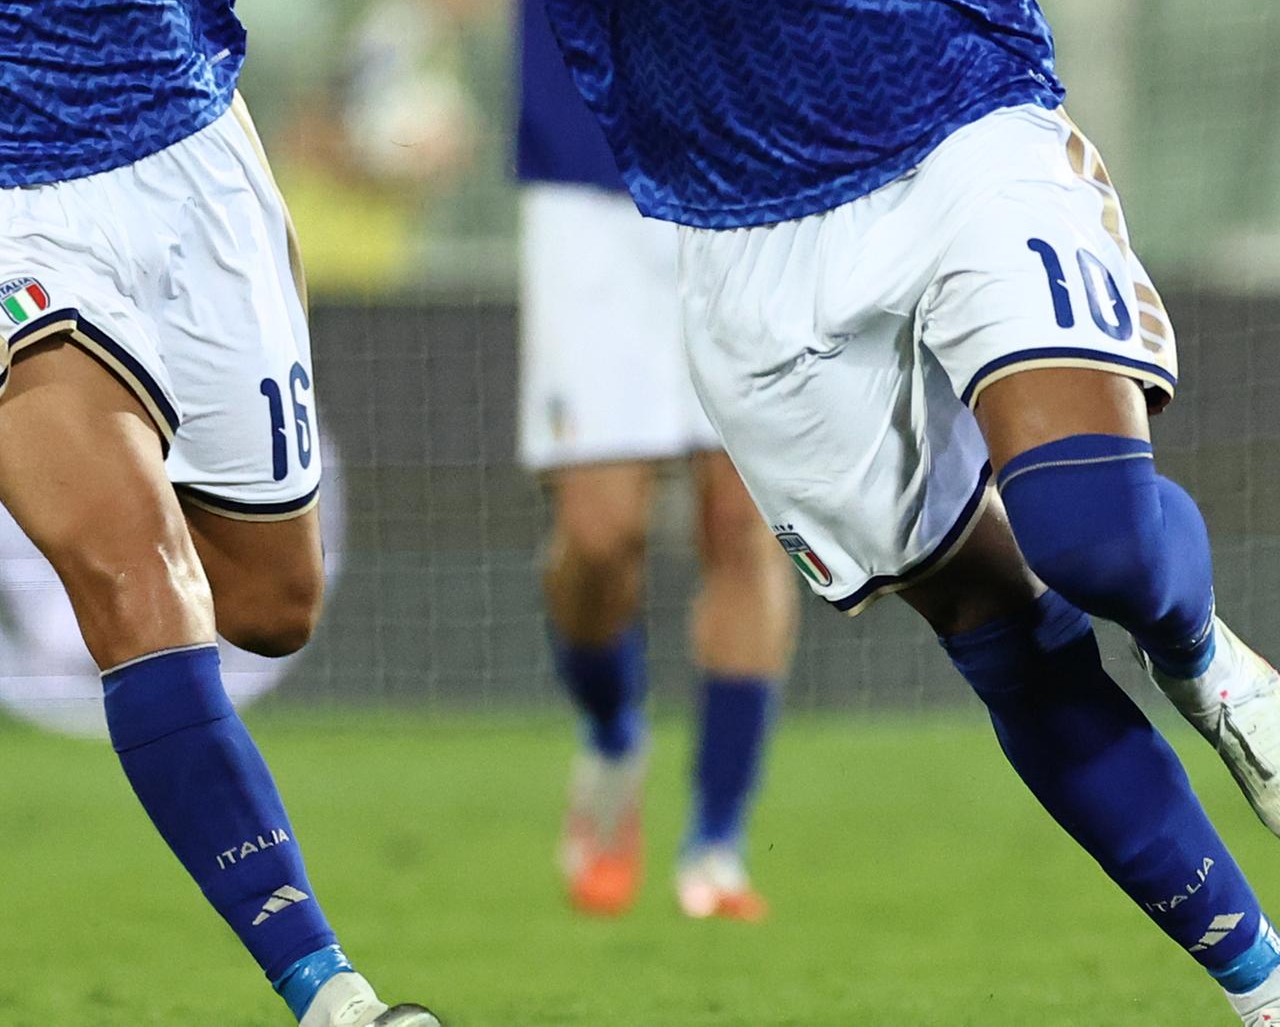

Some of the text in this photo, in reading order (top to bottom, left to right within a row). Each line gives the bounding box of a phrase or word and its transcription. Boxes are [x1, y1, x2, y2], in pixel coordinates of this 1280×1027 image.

[1026, 237, 1132, 341] 10
[260, 361, 312, 481] 16
[216, 828, 290, 870] ITALIA
[1145, 857, 1215, 912] ITALIA
